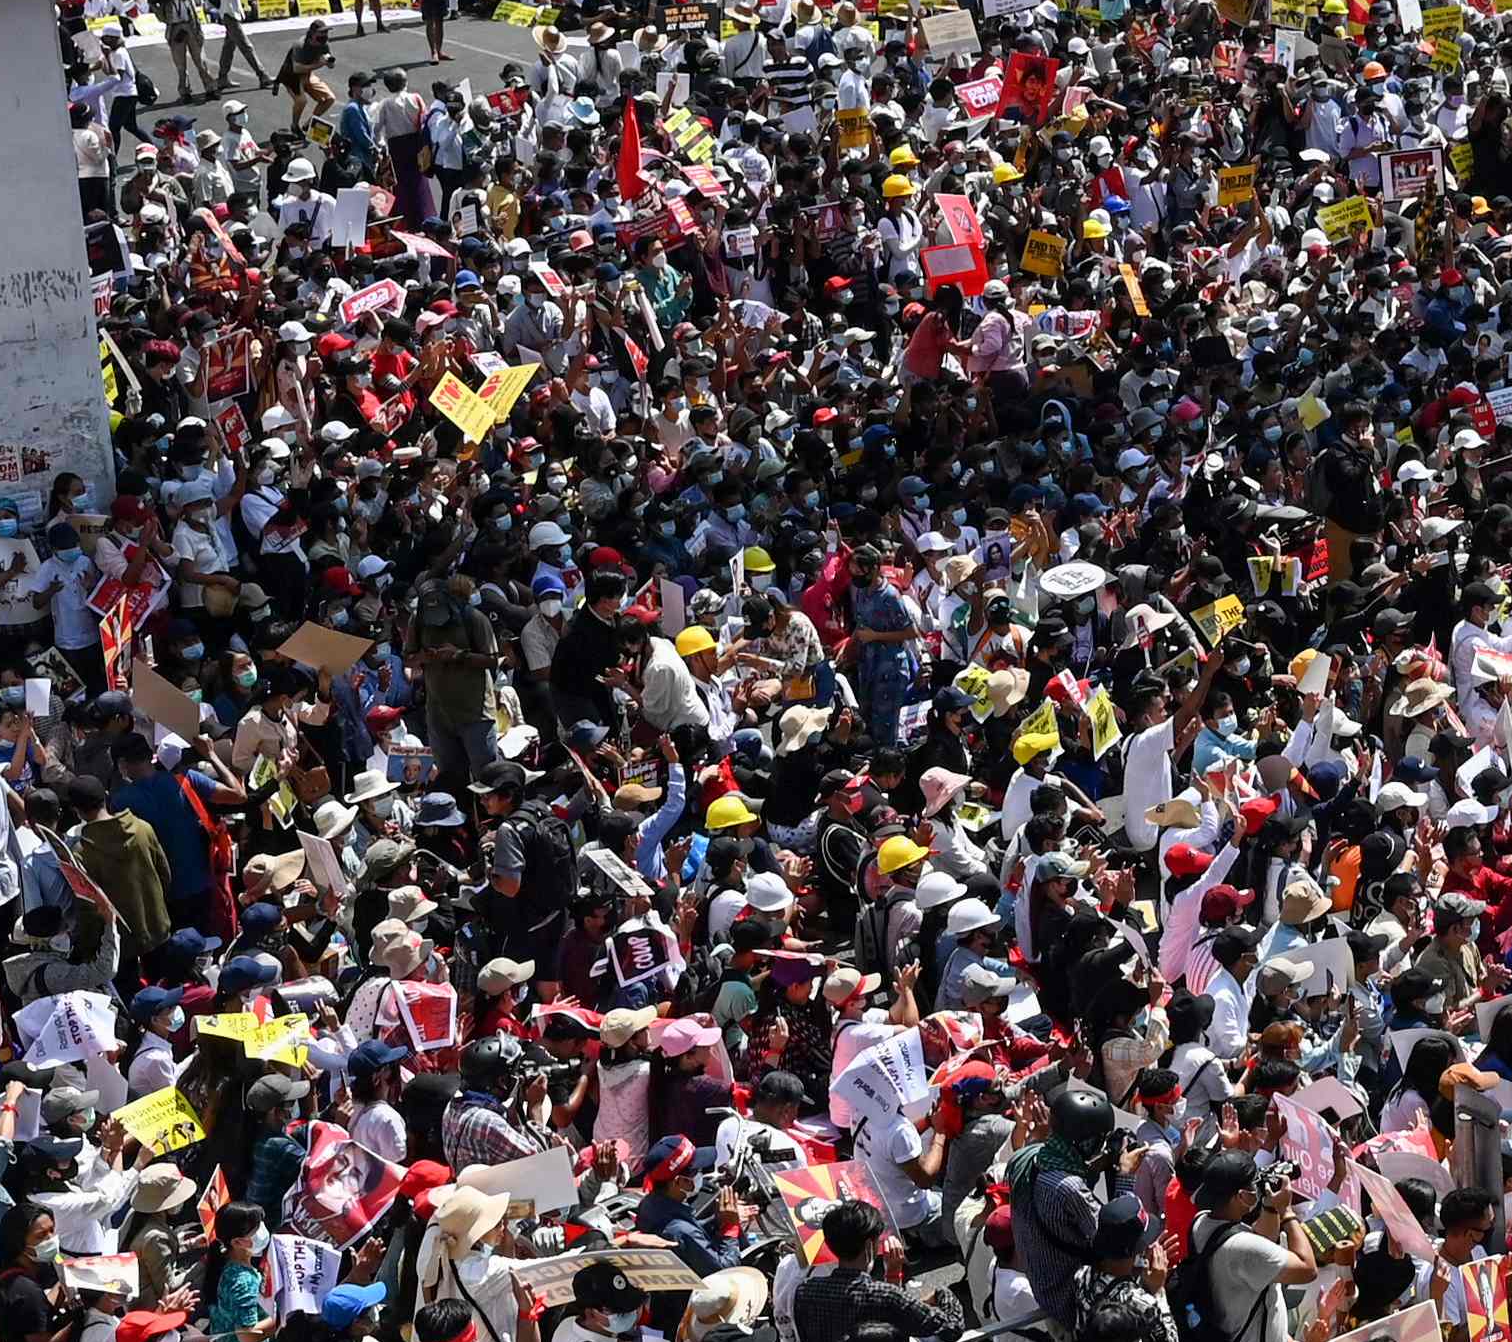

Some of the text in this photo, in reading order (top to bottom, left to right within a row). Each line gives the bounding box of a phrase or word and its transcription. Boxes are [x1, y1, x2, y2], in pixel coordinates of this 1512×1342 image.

[664, 5, 699, 15] WE ARE
[686, 13, 710, 22] SAFE
[666, 21, 707, 31] AT NIGHT
[1220, 605, 1239, 618] THE
